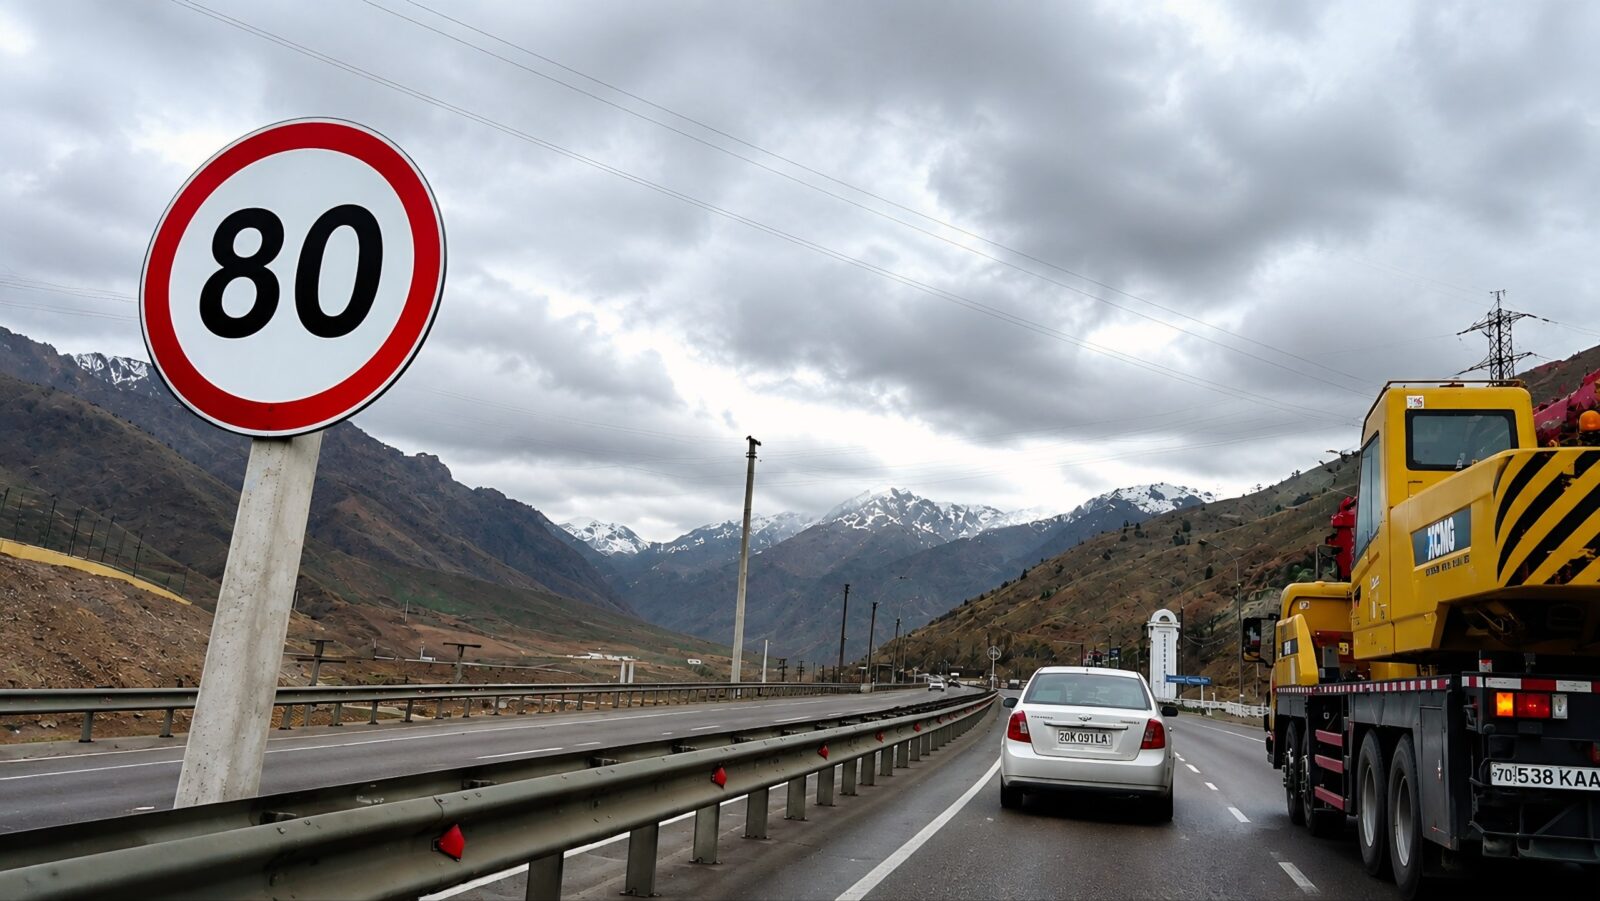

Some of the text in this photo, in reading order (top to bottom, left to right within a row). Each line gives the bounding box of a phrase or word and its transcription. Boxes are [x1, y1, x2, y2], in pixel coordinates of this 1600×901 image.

[199, 203, 383, 339] 80
[1427, 516, 1455, 560] XCMG
[1496, 768, 1512, 781] 70
[1517, 767, 1554, 785] 538
